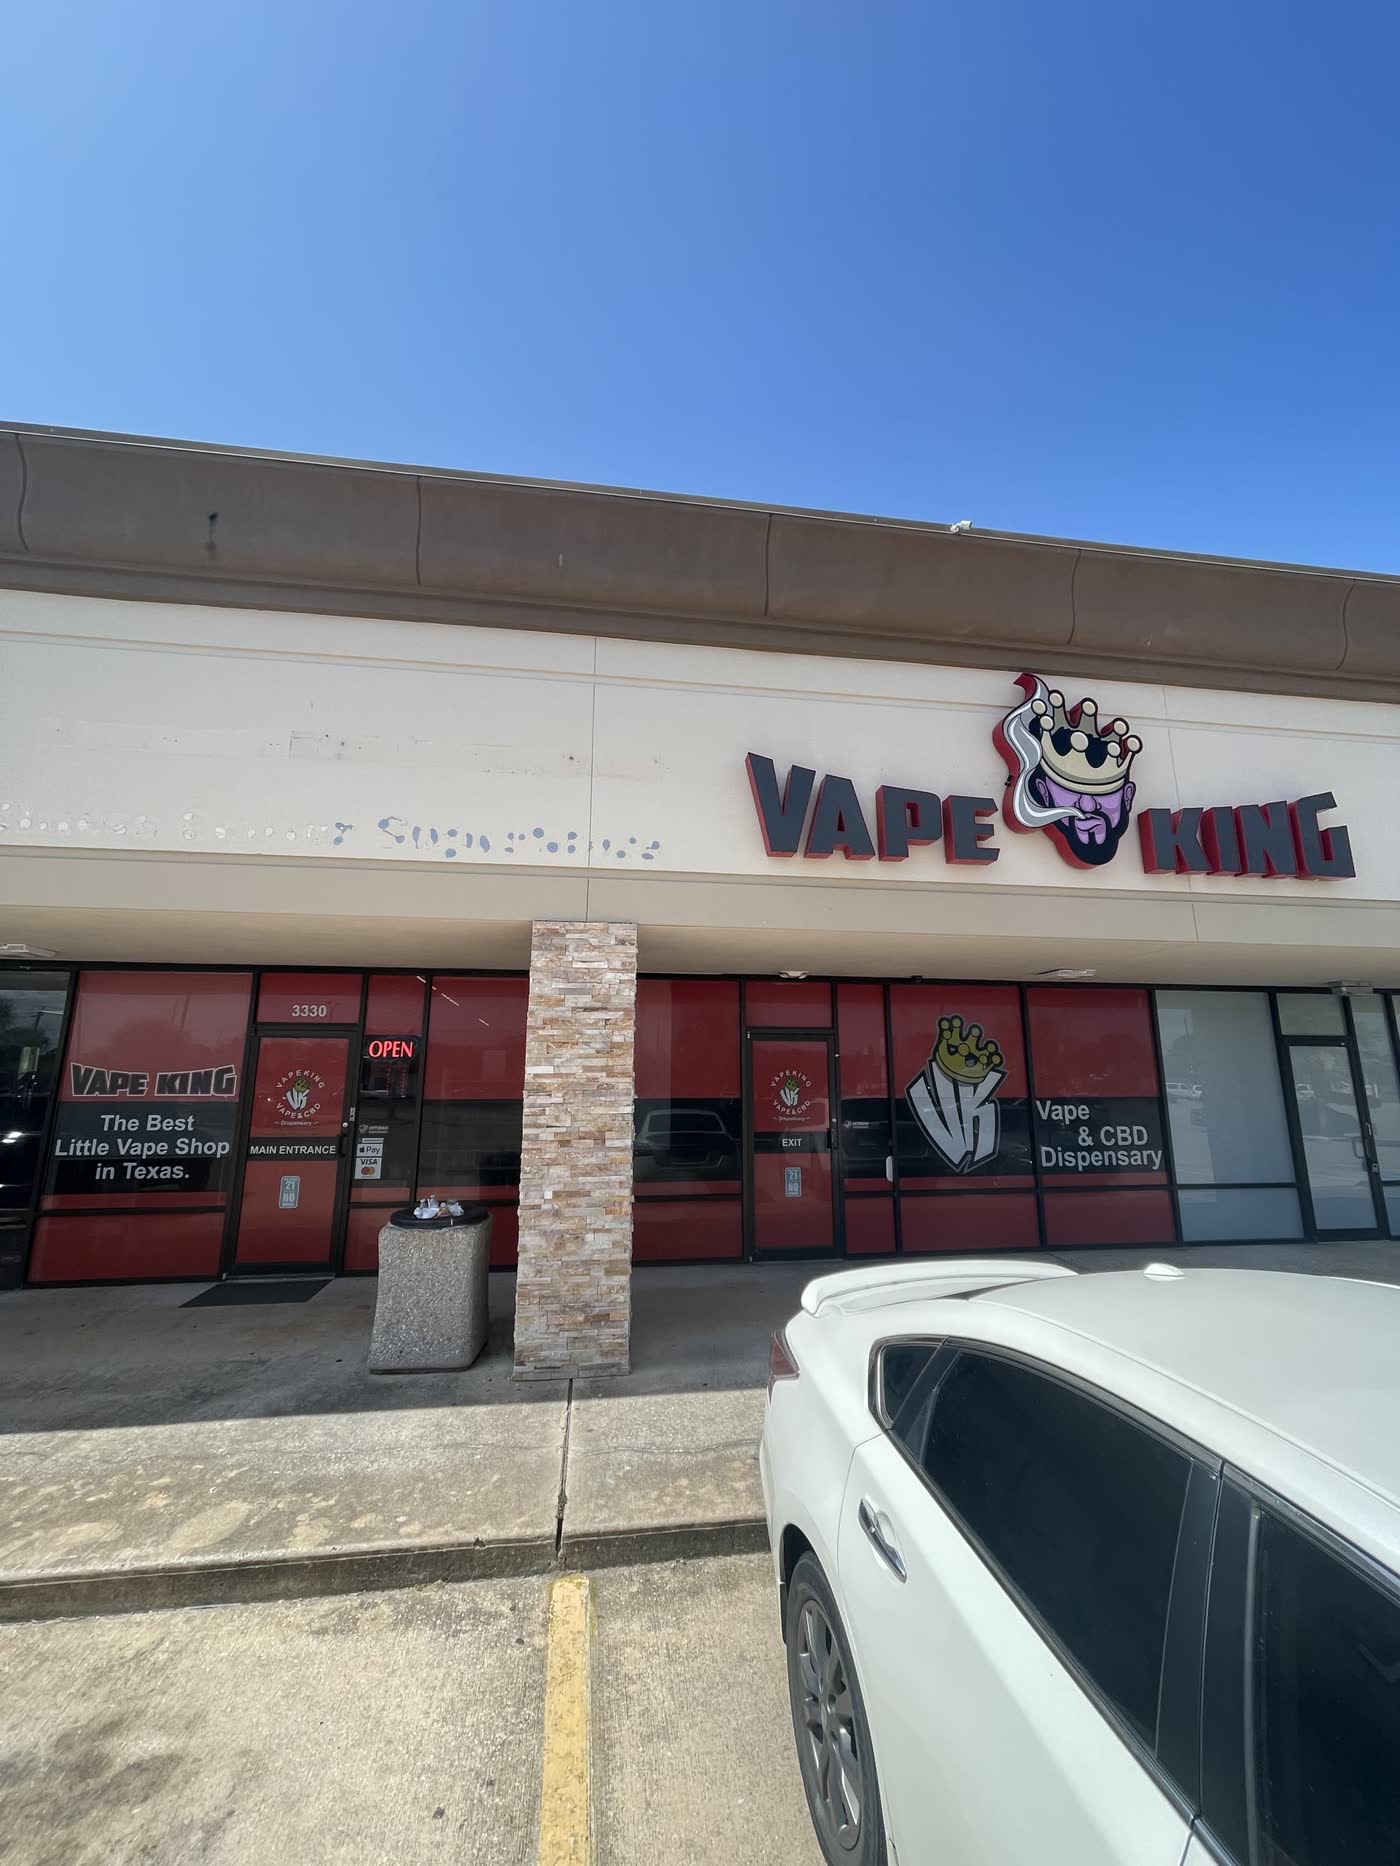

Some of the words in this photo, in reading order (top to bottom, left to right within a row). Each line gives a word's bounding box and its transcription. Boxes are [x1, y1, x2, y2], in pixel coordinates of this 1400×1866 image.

[745, 752, 1002, 865] VAPE
[1136, 792, 1356, 880] KING
[291, 1005, 327, 1017] 3330
[369, 1040, 413, 1058] OPEN
[71, 1062, 149, 1096] VAPE
[154, 1064, 237, 1096] KING
[1036, 1100, 1090, 1125] Vape
[101, 1115, 139, 1131] The
[146, 1115, 195, 1131] Best
[782, 1139, 802, 1147] EXIT
[1078, 1126, 1094, 1146] &
[1100, 1126, 1148, 1146] CBD
[55, 1139, 109, 1156] Little
[117, 1139, 168, 1159] Vape
[175, 1138, 230, 1158] Shop
[250, 1145, 277, 1155] MAIN
[279, 1145, 337, 1155] ENTRANCE
[366, 1146, 380, 1154] Pay
[1040, 1147, 1162, 1172] Dispensary
[95, 1163, 115, 1180] in
[123, 1162, 190, 1180] Texas.
[789, 1170, 798, 1180] 21
[285, 1181, 295, 1190] 21
[282, 1193, 296, 1203] NO
